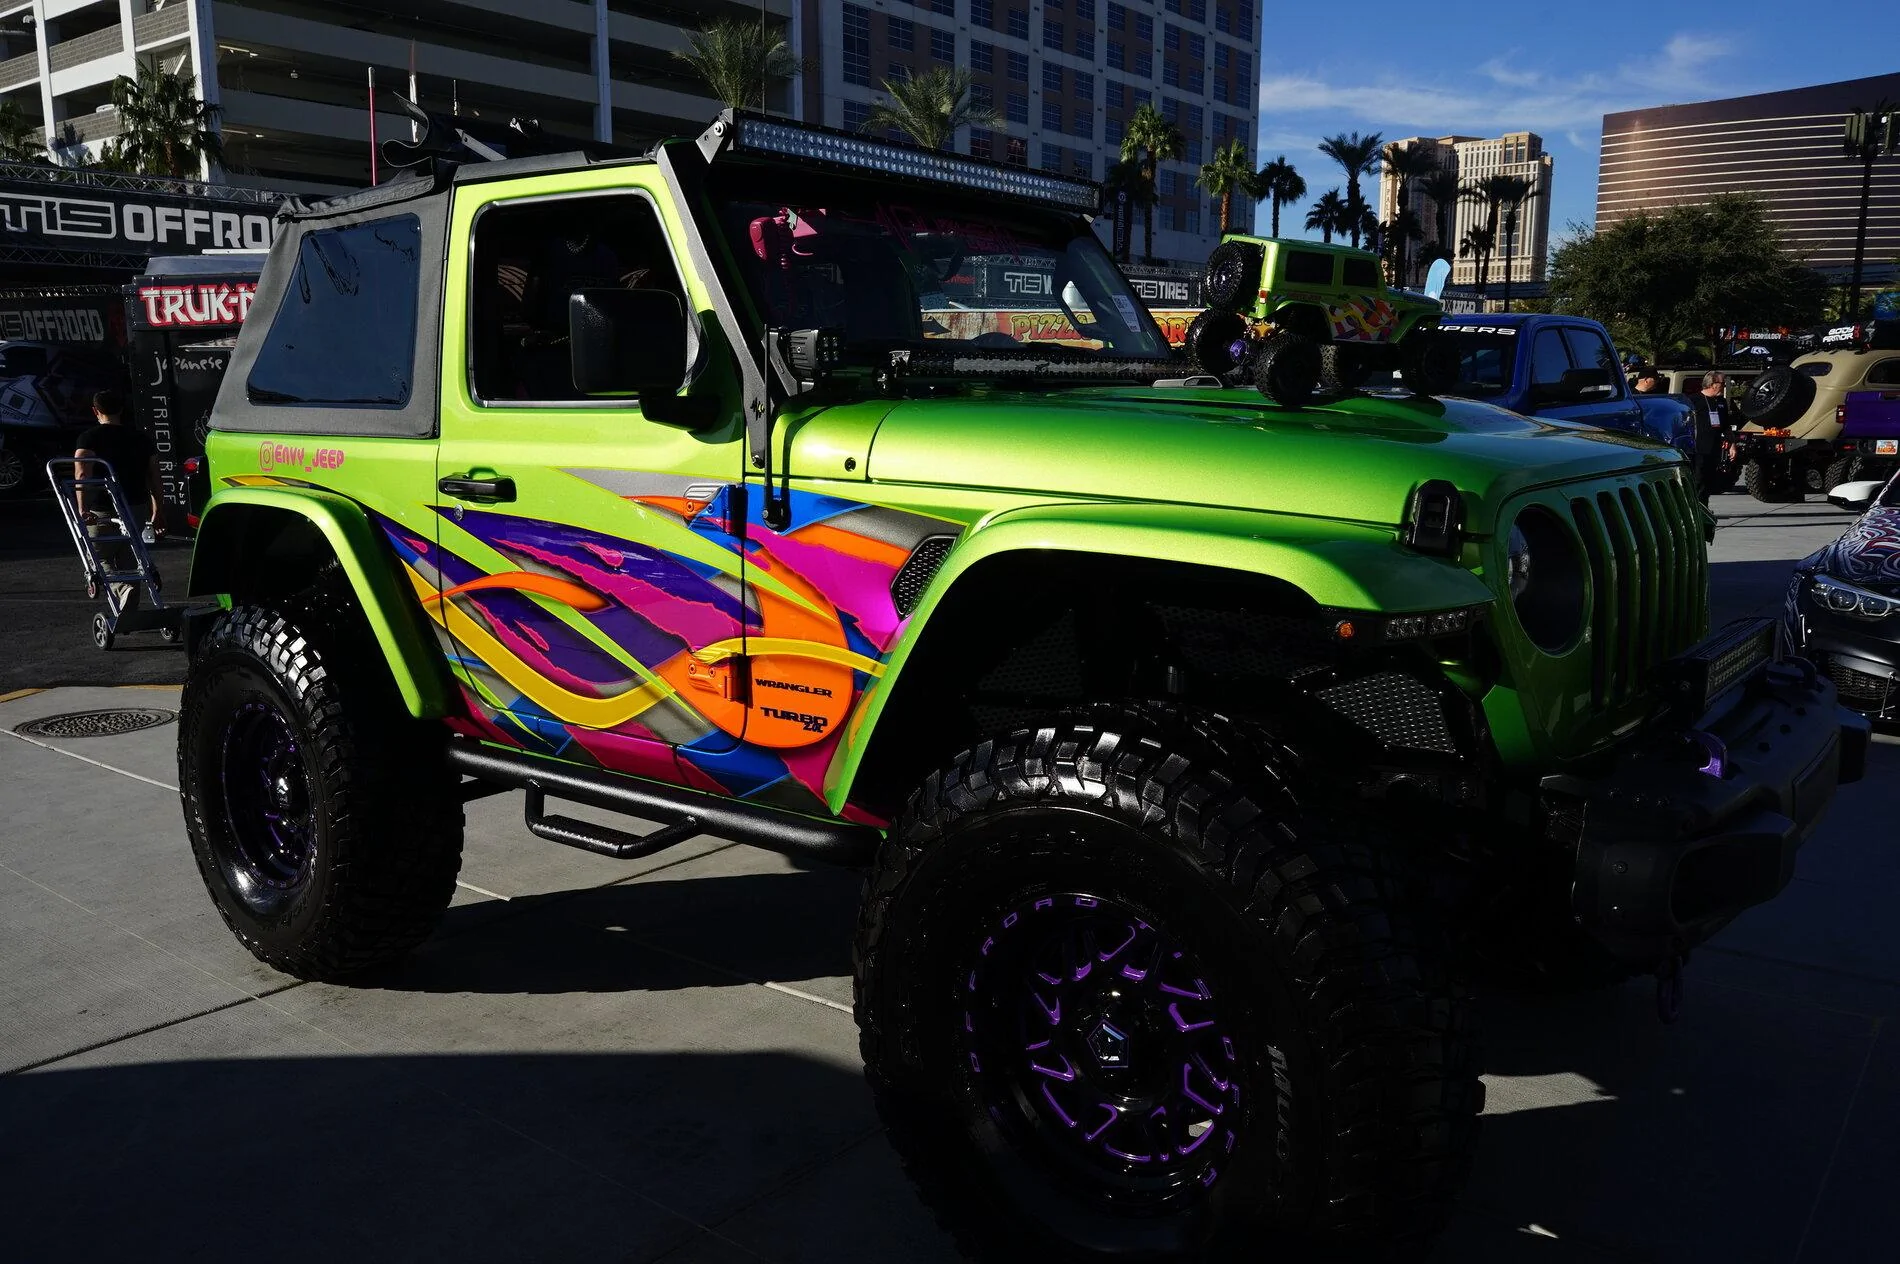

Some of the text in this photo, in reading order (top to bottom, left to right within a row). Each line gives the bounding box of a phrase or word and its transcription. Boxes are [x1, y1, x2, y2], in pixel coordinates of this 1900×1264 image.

[122, 203, 281, 250] OFFRO
[1158, 280, 1189, 300] TIRES
[22, 309, 104, 341] OFFROAD
[1828, 326, 1855, 337] BODY
[1822, 333, 1854, 344] ARMOR
[152, 396, 172, 453] FRIED
[755, 679, 833, 698] WRANGLER
[760, 706, 828, 727] TURBO
